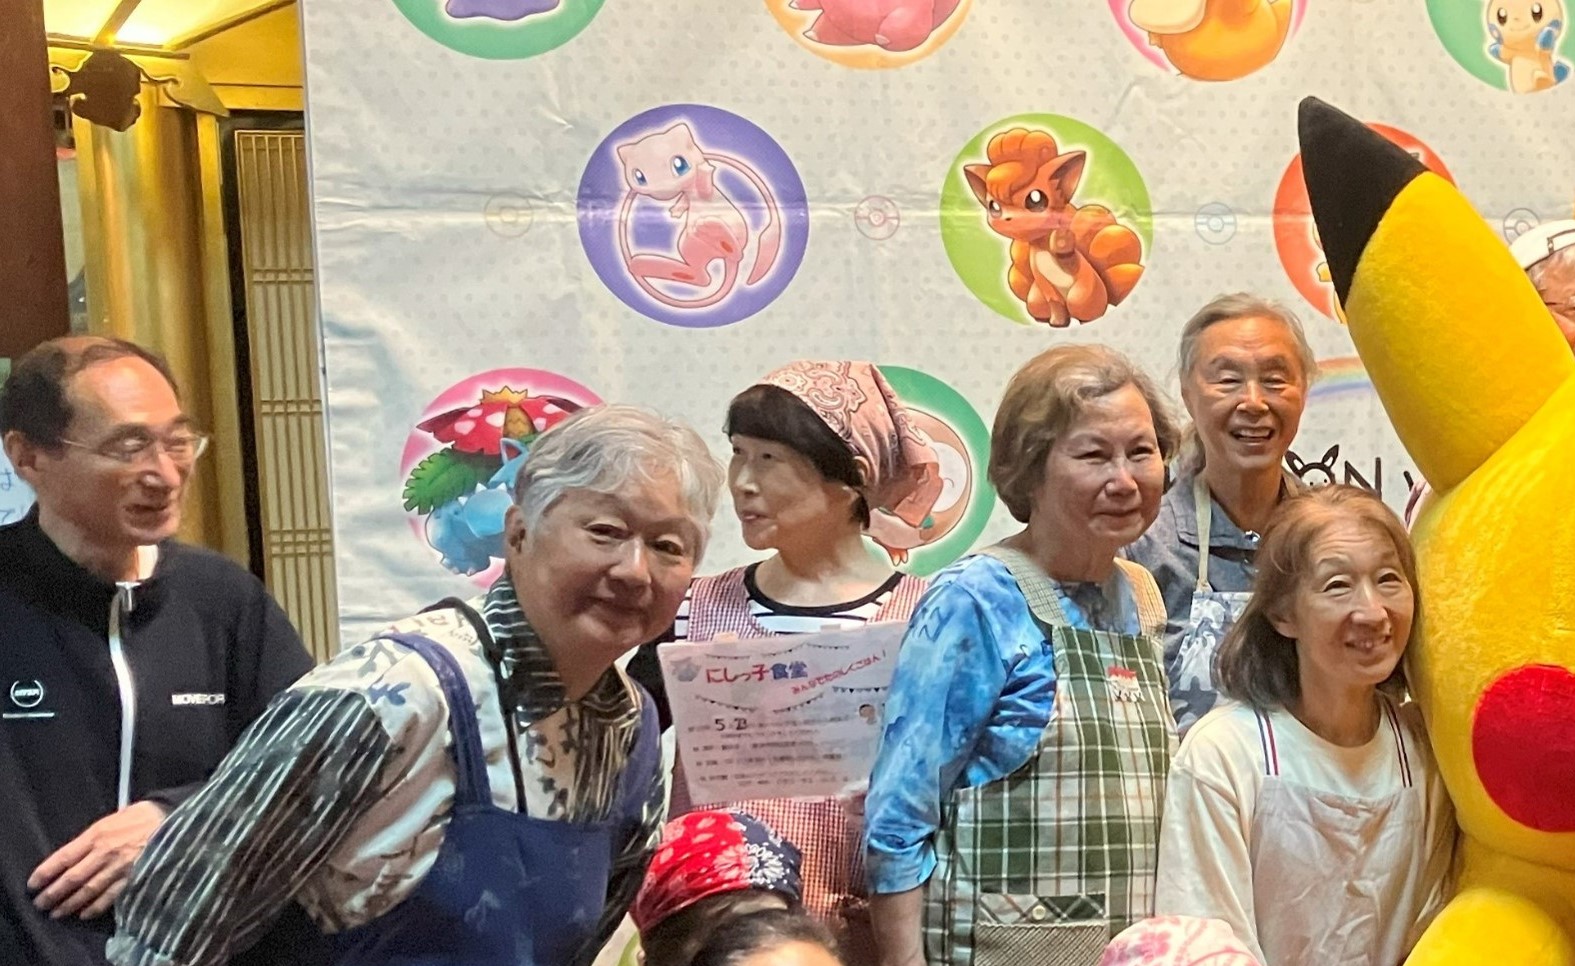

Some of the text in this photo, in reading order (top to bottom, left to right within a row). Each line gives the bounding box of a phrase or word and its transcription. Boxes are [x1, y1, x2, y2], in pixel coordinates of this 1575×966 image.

[706, 660, 809, 684] にしっ子食堂
